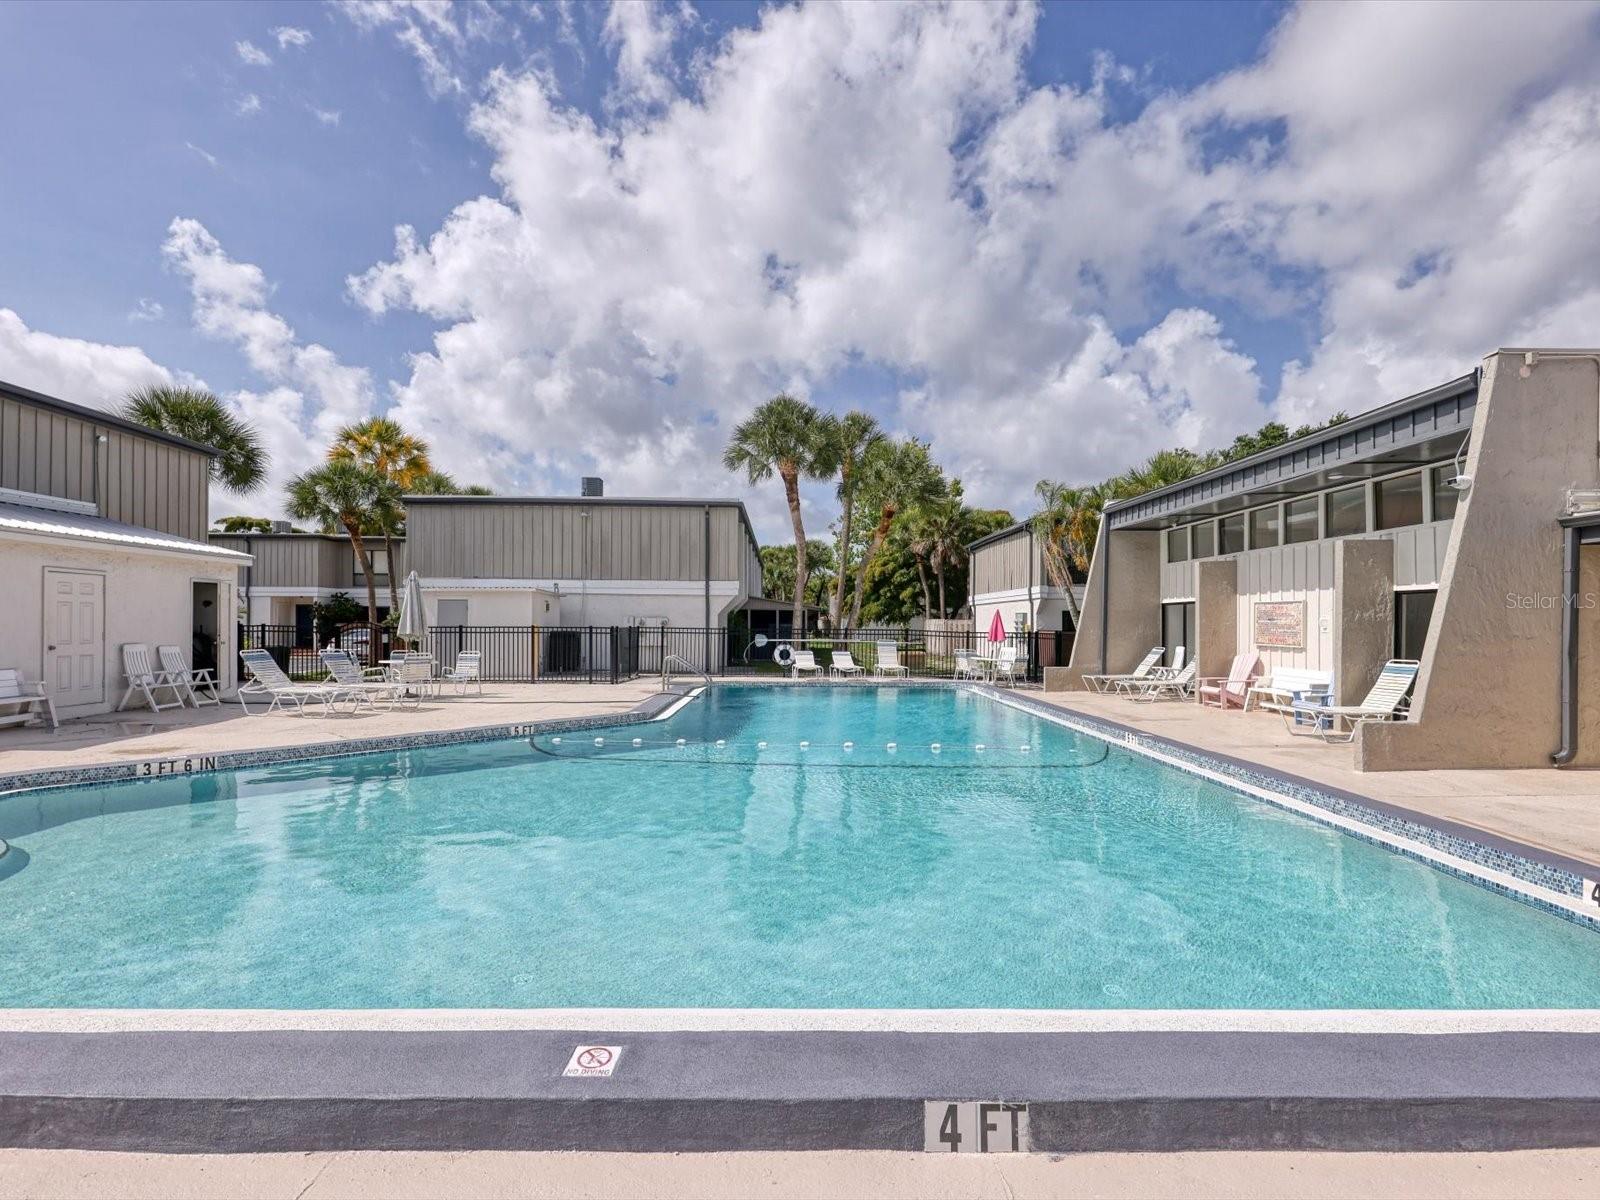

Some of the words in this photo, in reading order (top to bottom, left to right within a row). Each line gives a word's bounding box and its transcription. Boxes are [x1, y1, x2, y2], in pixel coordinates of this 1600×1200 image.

[143, 763, 151, 776] 3
[159, 760, 177, 775] FT
[184, 759, 192, 772] 6
[200, 757, 216, 771] IN
[939, 1104, 962, 1152] 4
[980, 1103, 1027, 1152] FT
